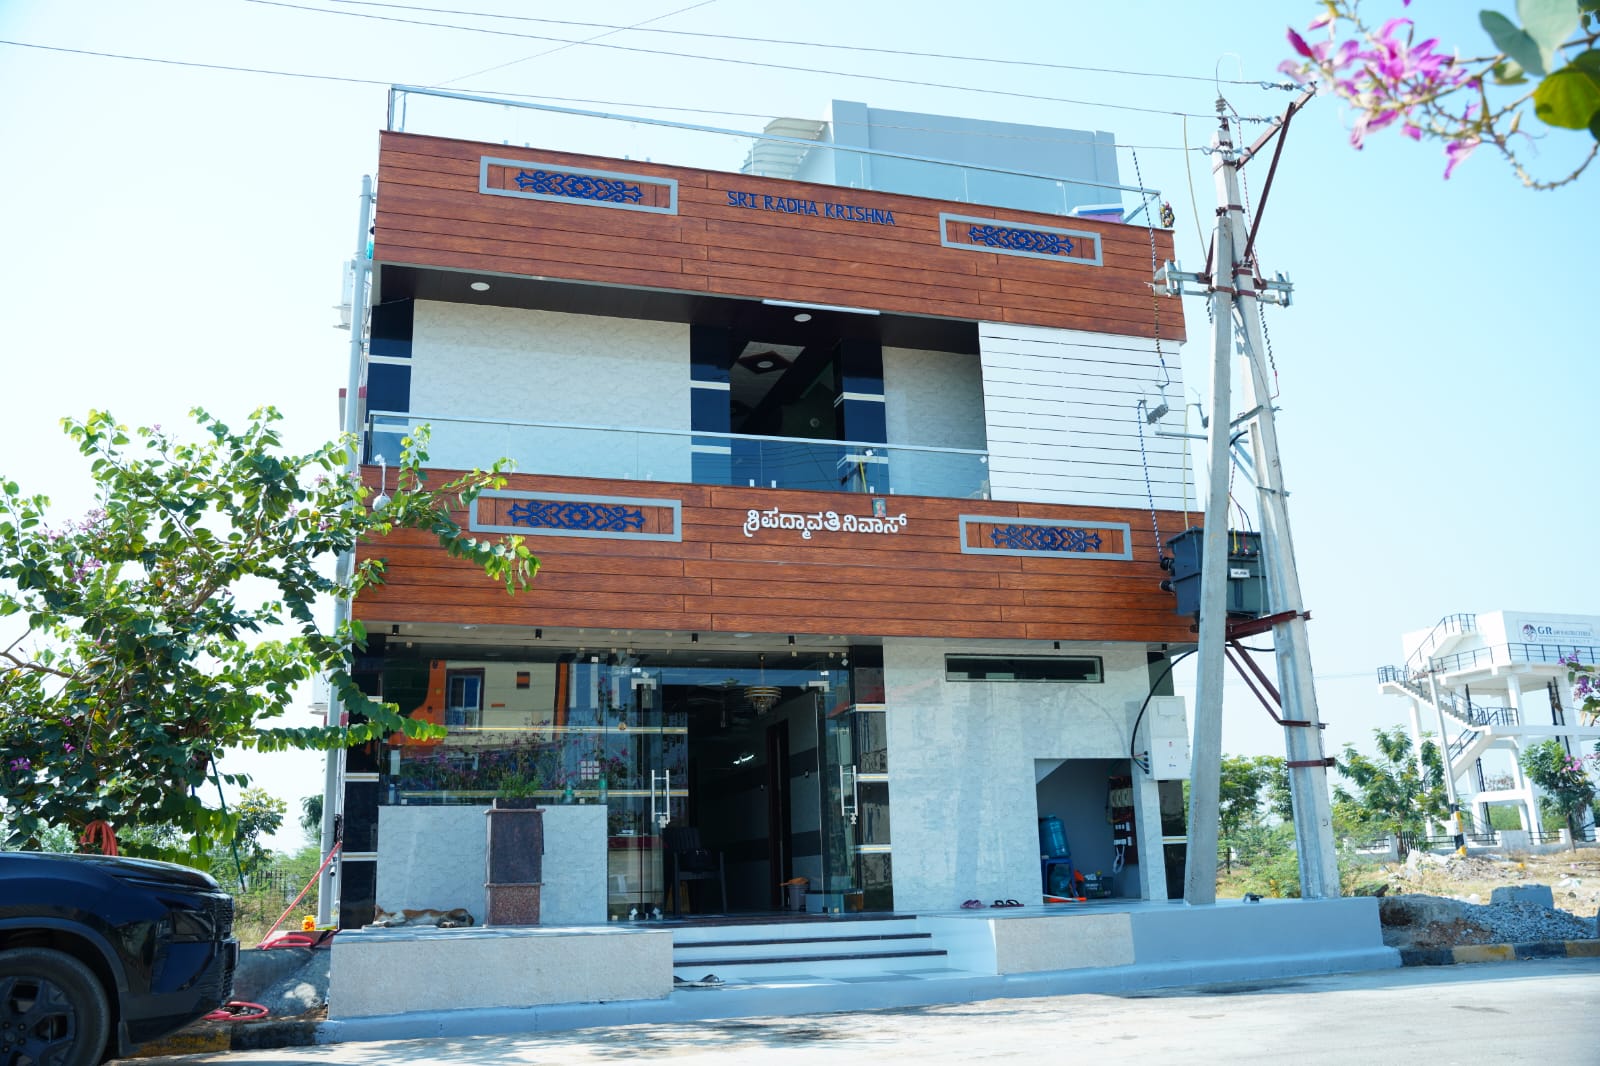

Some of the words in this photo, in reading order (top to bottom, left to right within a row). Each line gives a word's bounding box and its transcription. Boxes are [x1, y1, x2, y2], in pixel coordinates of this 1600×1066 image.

[727, 190, 758, 209] SRI
[763, 194, 819, 216] RADHA
[824, 203, 896, 225] KRISHNA
